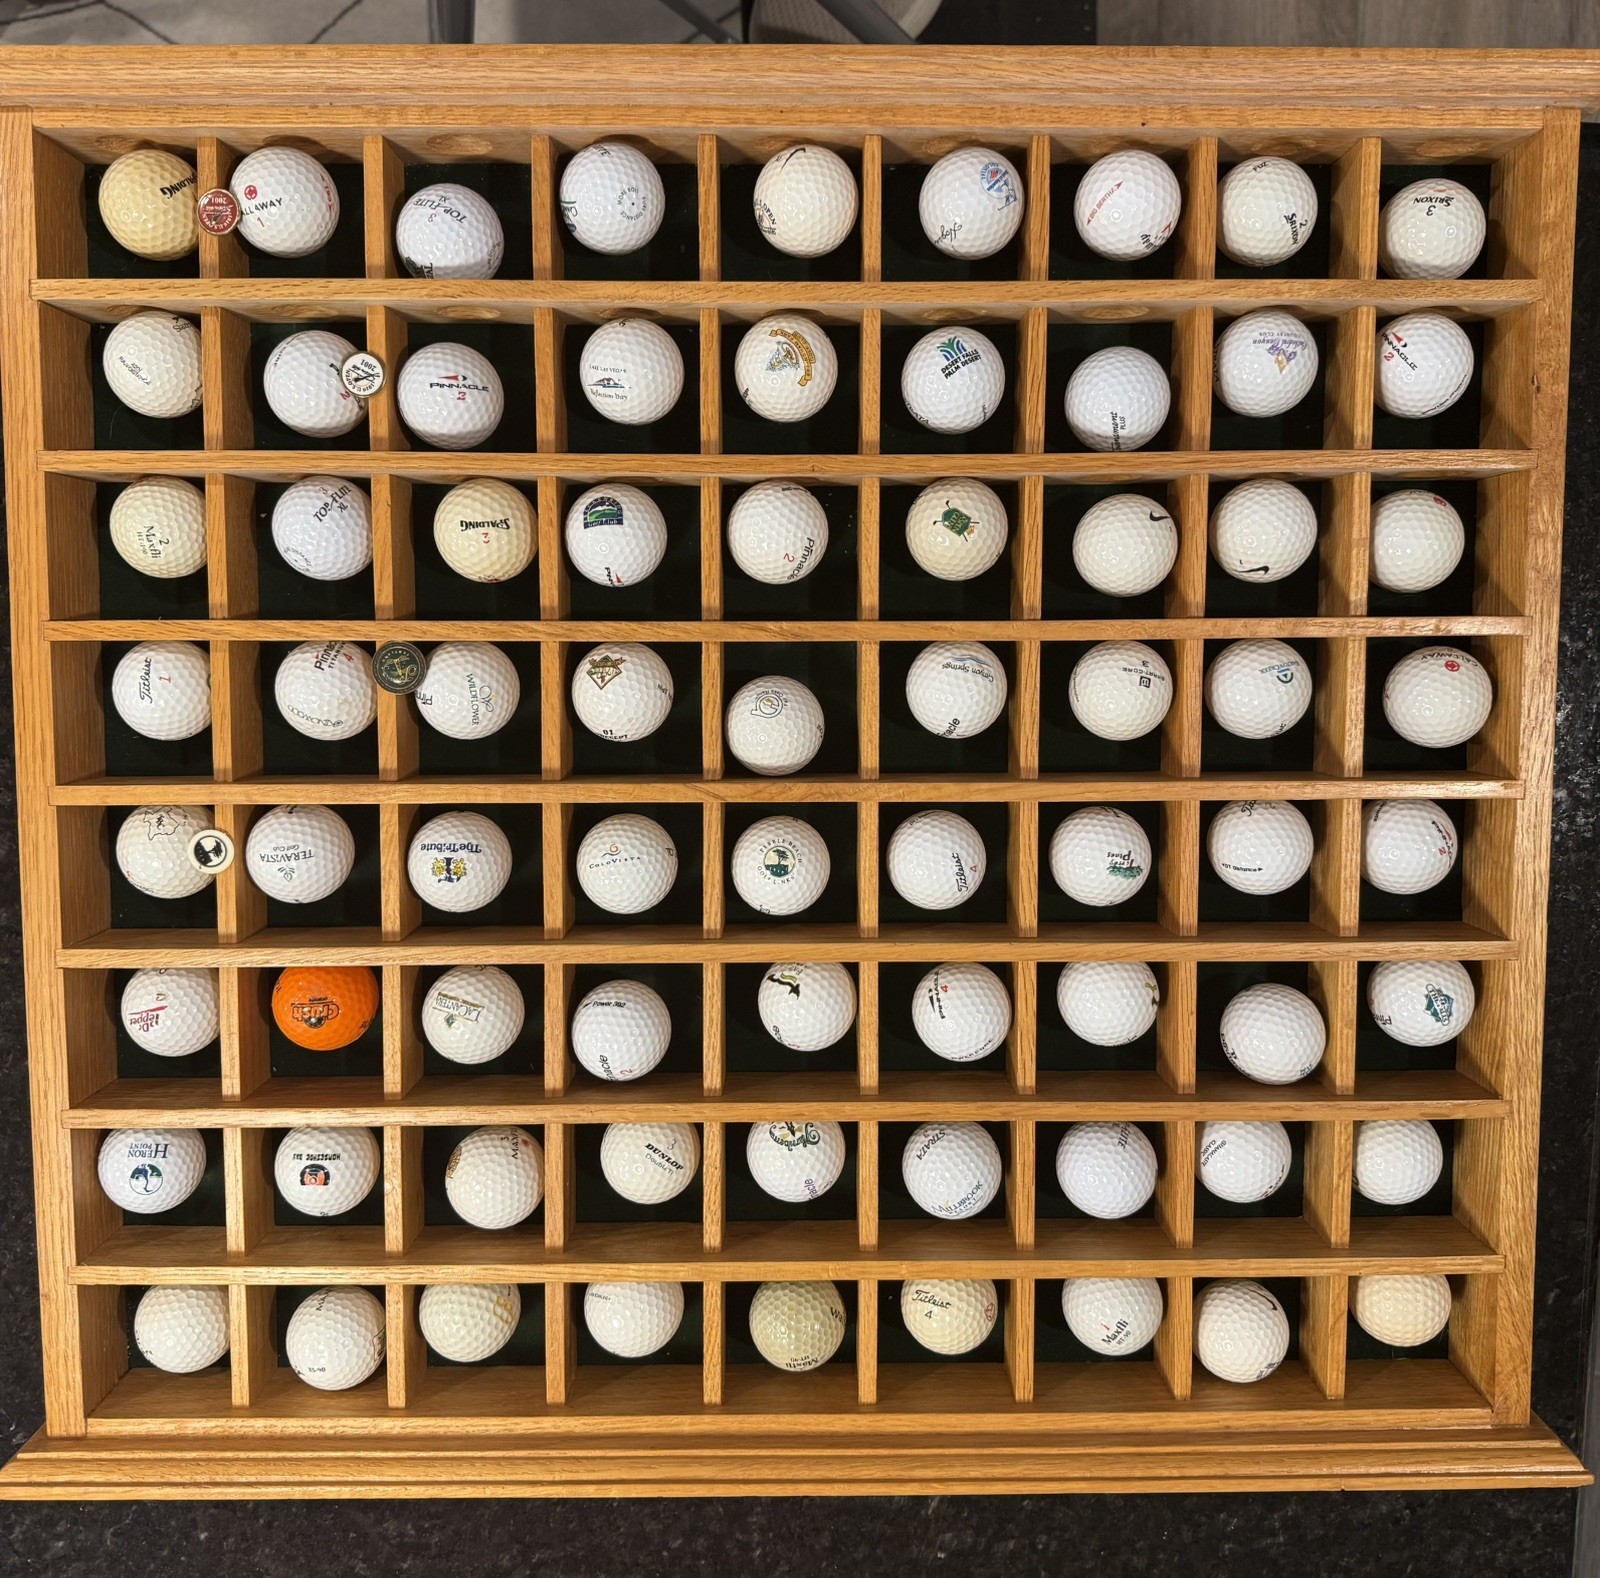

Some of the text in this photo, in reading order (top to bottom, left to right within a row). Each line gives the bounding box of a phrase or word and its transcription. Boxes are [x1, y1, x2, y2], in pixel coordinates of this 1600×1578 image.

[160, 171, 197, 199] PALDING
[210, 196, 227, 204] 2001
[1413, 196, 1454, 208] SRIXON
[241, 197, 283, 216] ALLAWAY
[1426, 205, 1436, 216] 3
[427, 212, 437, 222] 3
[619, 209, 644, 221] DISTANCE
[256, 216, 265, 228] 1
[1299, 219, 1308, 229] 2
[1283, 213, 1299, 245] SRIXON
[1381, 333, 1418, 371] PINNACLE
[1383, 352, 1395, 361] 2
[360, 358, 376, 371] 2001
[940, 349, 979, 374] DESERT FALLS
[944, 354, 982, 379] PALM DESERT
[429, 382, 489, 392] PINNACLE
[339, 391, 350, 400] 2
[456, 391, 467, 401] 2
[614, 393, 628, 401] Bay
[318, 486, 328, 495] 3
[460, 518, 511, 532] SPALDING
[144, 525, 161, 559] Maxfli
[158, 538, 170, 546] 2
[481, 532, 491, 544] 2
[783, 552, 795, 562] 2
[787, 537, 815, 580] Pinnacle
[314, 641, 338, 671] Pinnac
[345, 652, 354, 661] 4
[1421, 652, 1478, 667] CALLAWAY
[942, 662, 994, 683] Canyon Springs
[140, 658, 152, 703] Titleist
[466, 673, 480, 727] WILDFLOWER
[285, 844, 300, 852] Golf
[420, 842, 483, 854] The Tribute
[760, 838, 803, 864] PEBBLE BEACH
[1438, 847, 1446, 855] 2
[259, 849, 314, 863] TERAVISTA
[1107, 851, 1131, 861] Pines
[952, 853, 968, 893] Titleist
[941, 984, 949, 993] 4
[291, 1003, 339, 1022] Crush
[130, 1012, 160, 1028] Pepper
[667, 1139, 677, 1150] 3
[916, 1129, 946, 1160] STRATA
[644, 1142, 684, 1171] DUNLOP
[645, 1153, 667, 1172] Double
[912, 1289, 951, 1309] Titleist
[924, 1310, 933, 1320] 4
[1101, 1323, 1111, 1331] 1
[1101, 1319, 1129, 1345] Maxfli
